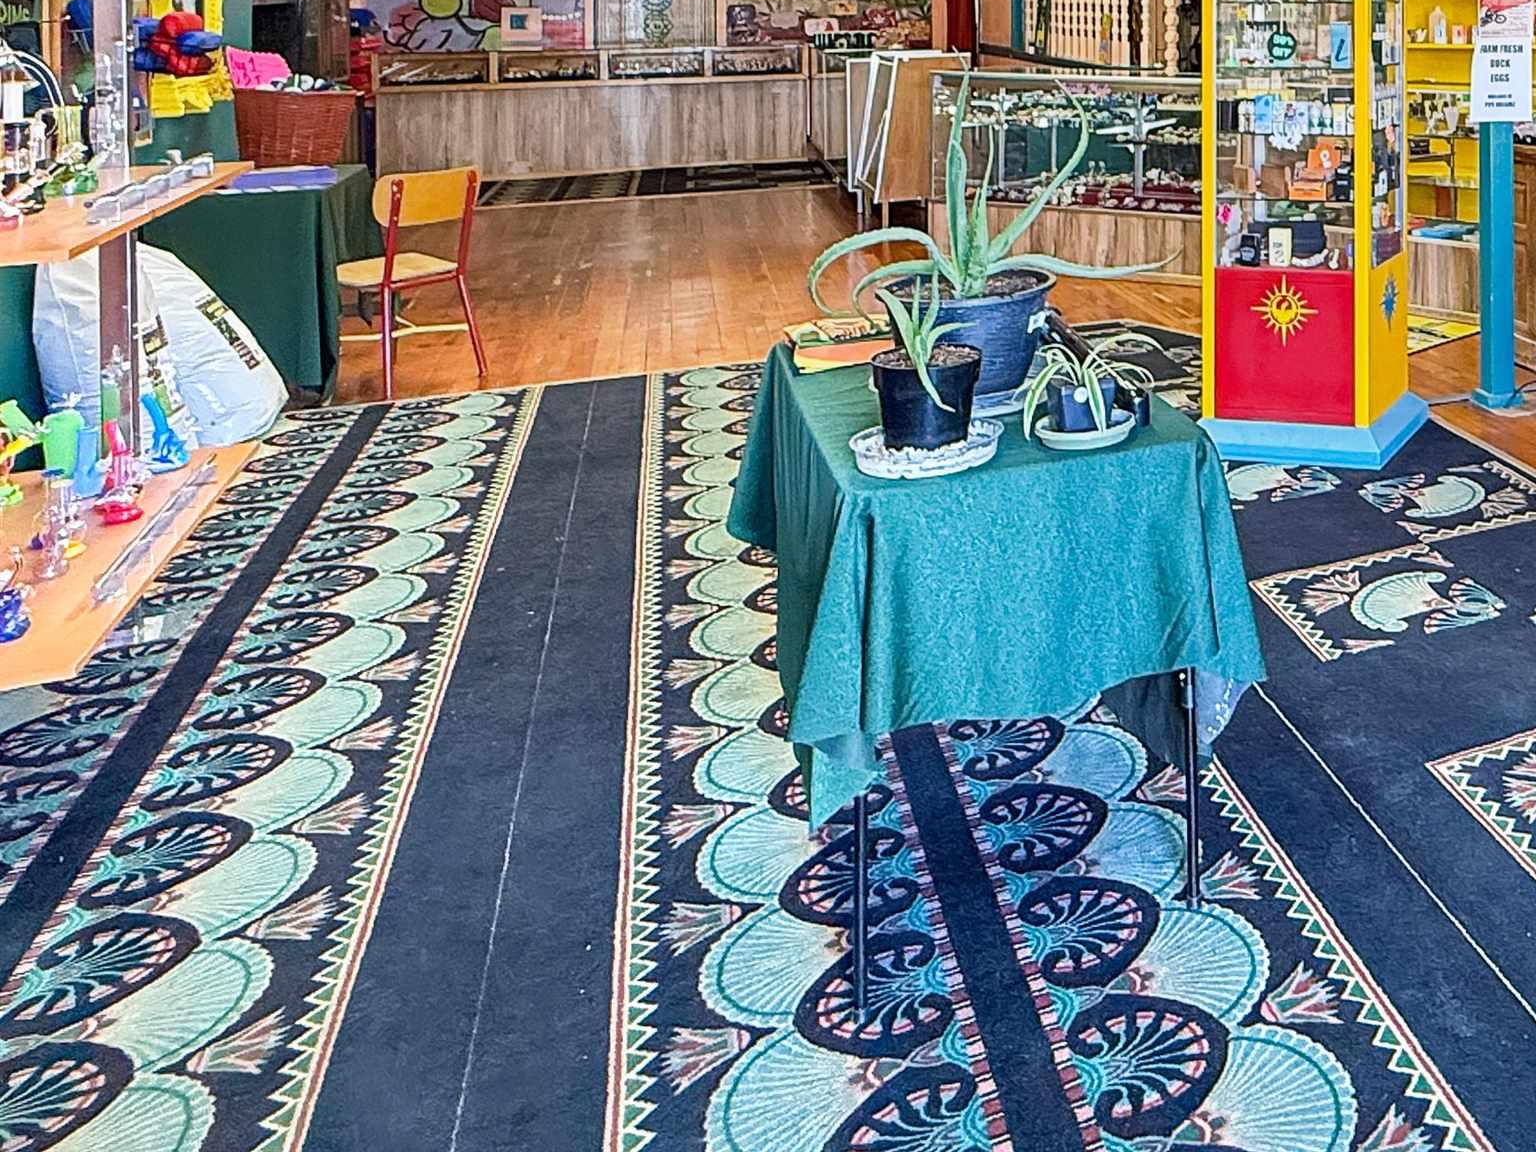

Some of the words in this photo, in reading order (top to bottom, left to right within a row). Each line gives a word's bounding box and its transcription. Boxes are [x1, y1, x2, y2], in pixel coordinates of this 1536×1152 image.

[1499, 44, 1524, 53] FRESH
[1490, 59, 1511, 68] DUCK
[1490, 73, 1510, 83] EGGS
